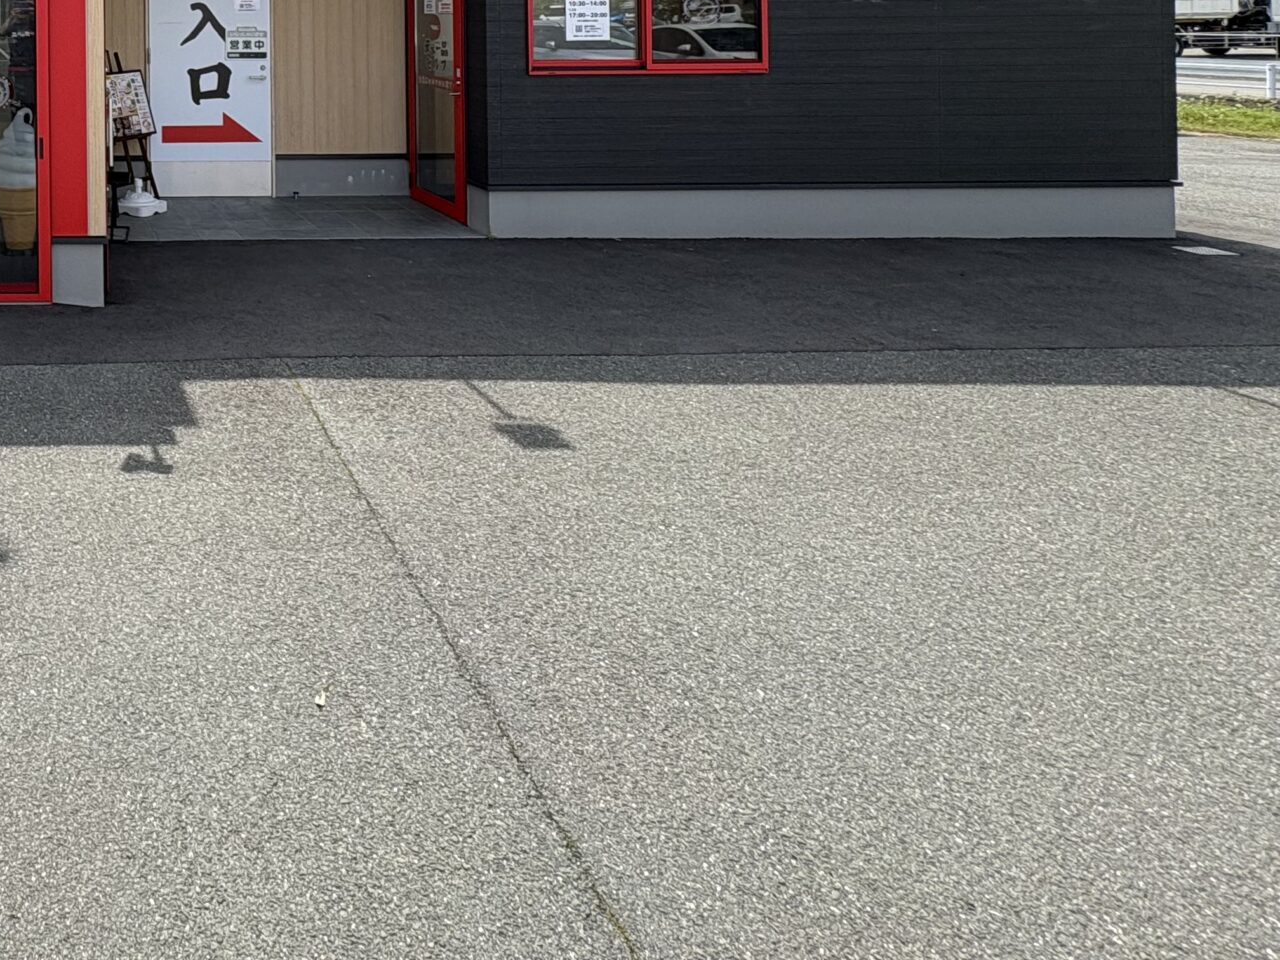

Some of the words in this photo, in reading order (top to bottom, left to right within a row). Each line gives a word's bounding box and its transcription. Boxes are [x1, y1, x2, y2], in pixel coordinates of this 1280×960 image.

[180, 2, 232, 106] 入口
[229, 39, 265, 50] 営業中
